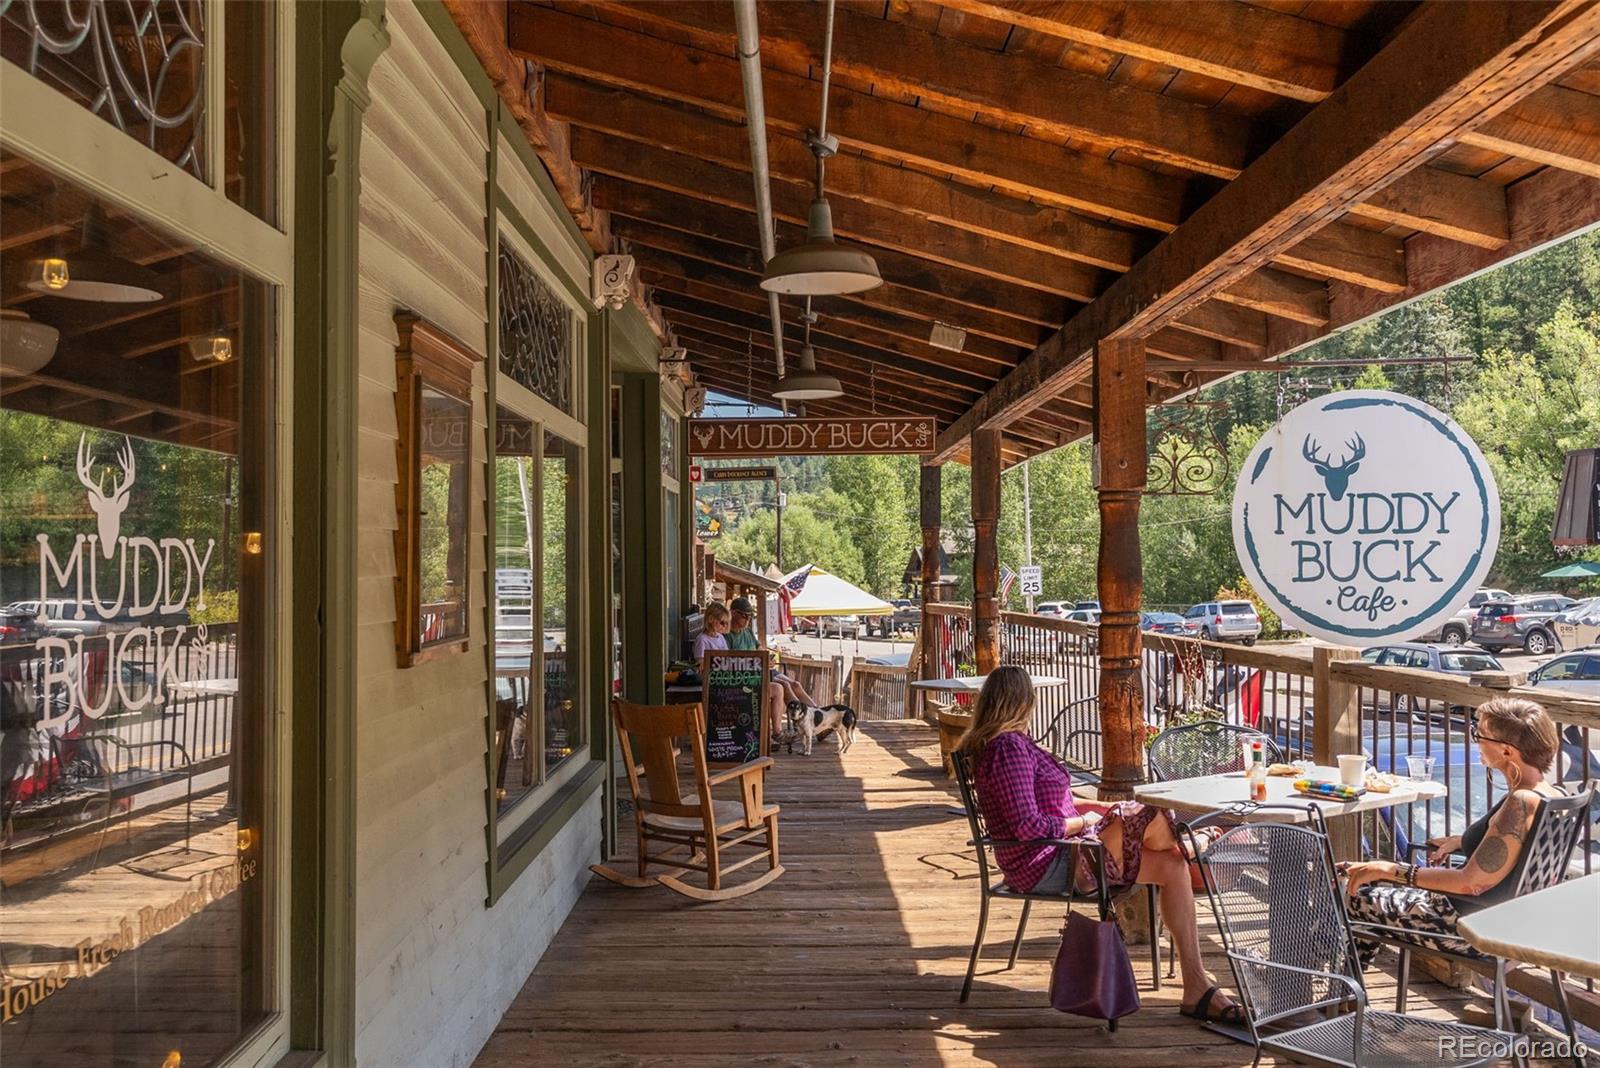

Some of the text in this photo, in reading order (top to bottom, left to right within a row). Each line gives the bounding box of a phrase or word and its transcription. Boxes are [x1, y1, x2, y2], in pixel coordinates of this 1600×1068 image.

[719, 422, 916, 449] MUDDY BUCK
[1273, 491, 1460, 535] MUDDY
[36, 533, 215, 623] MUDDY
[1290, 539, 1444, 583] BUCK
[1023, 582, 1040, 592] 25
[1337, 585, 1397, 622] Cafe
[36, 625, 190, 730] BUCK
[712, 656, 762, 671] SUMMER
[75, 916, 135, 979] Fresh
[138, 874, 208, 941] Roasted
[209, 855, 257, 901] Coffee
